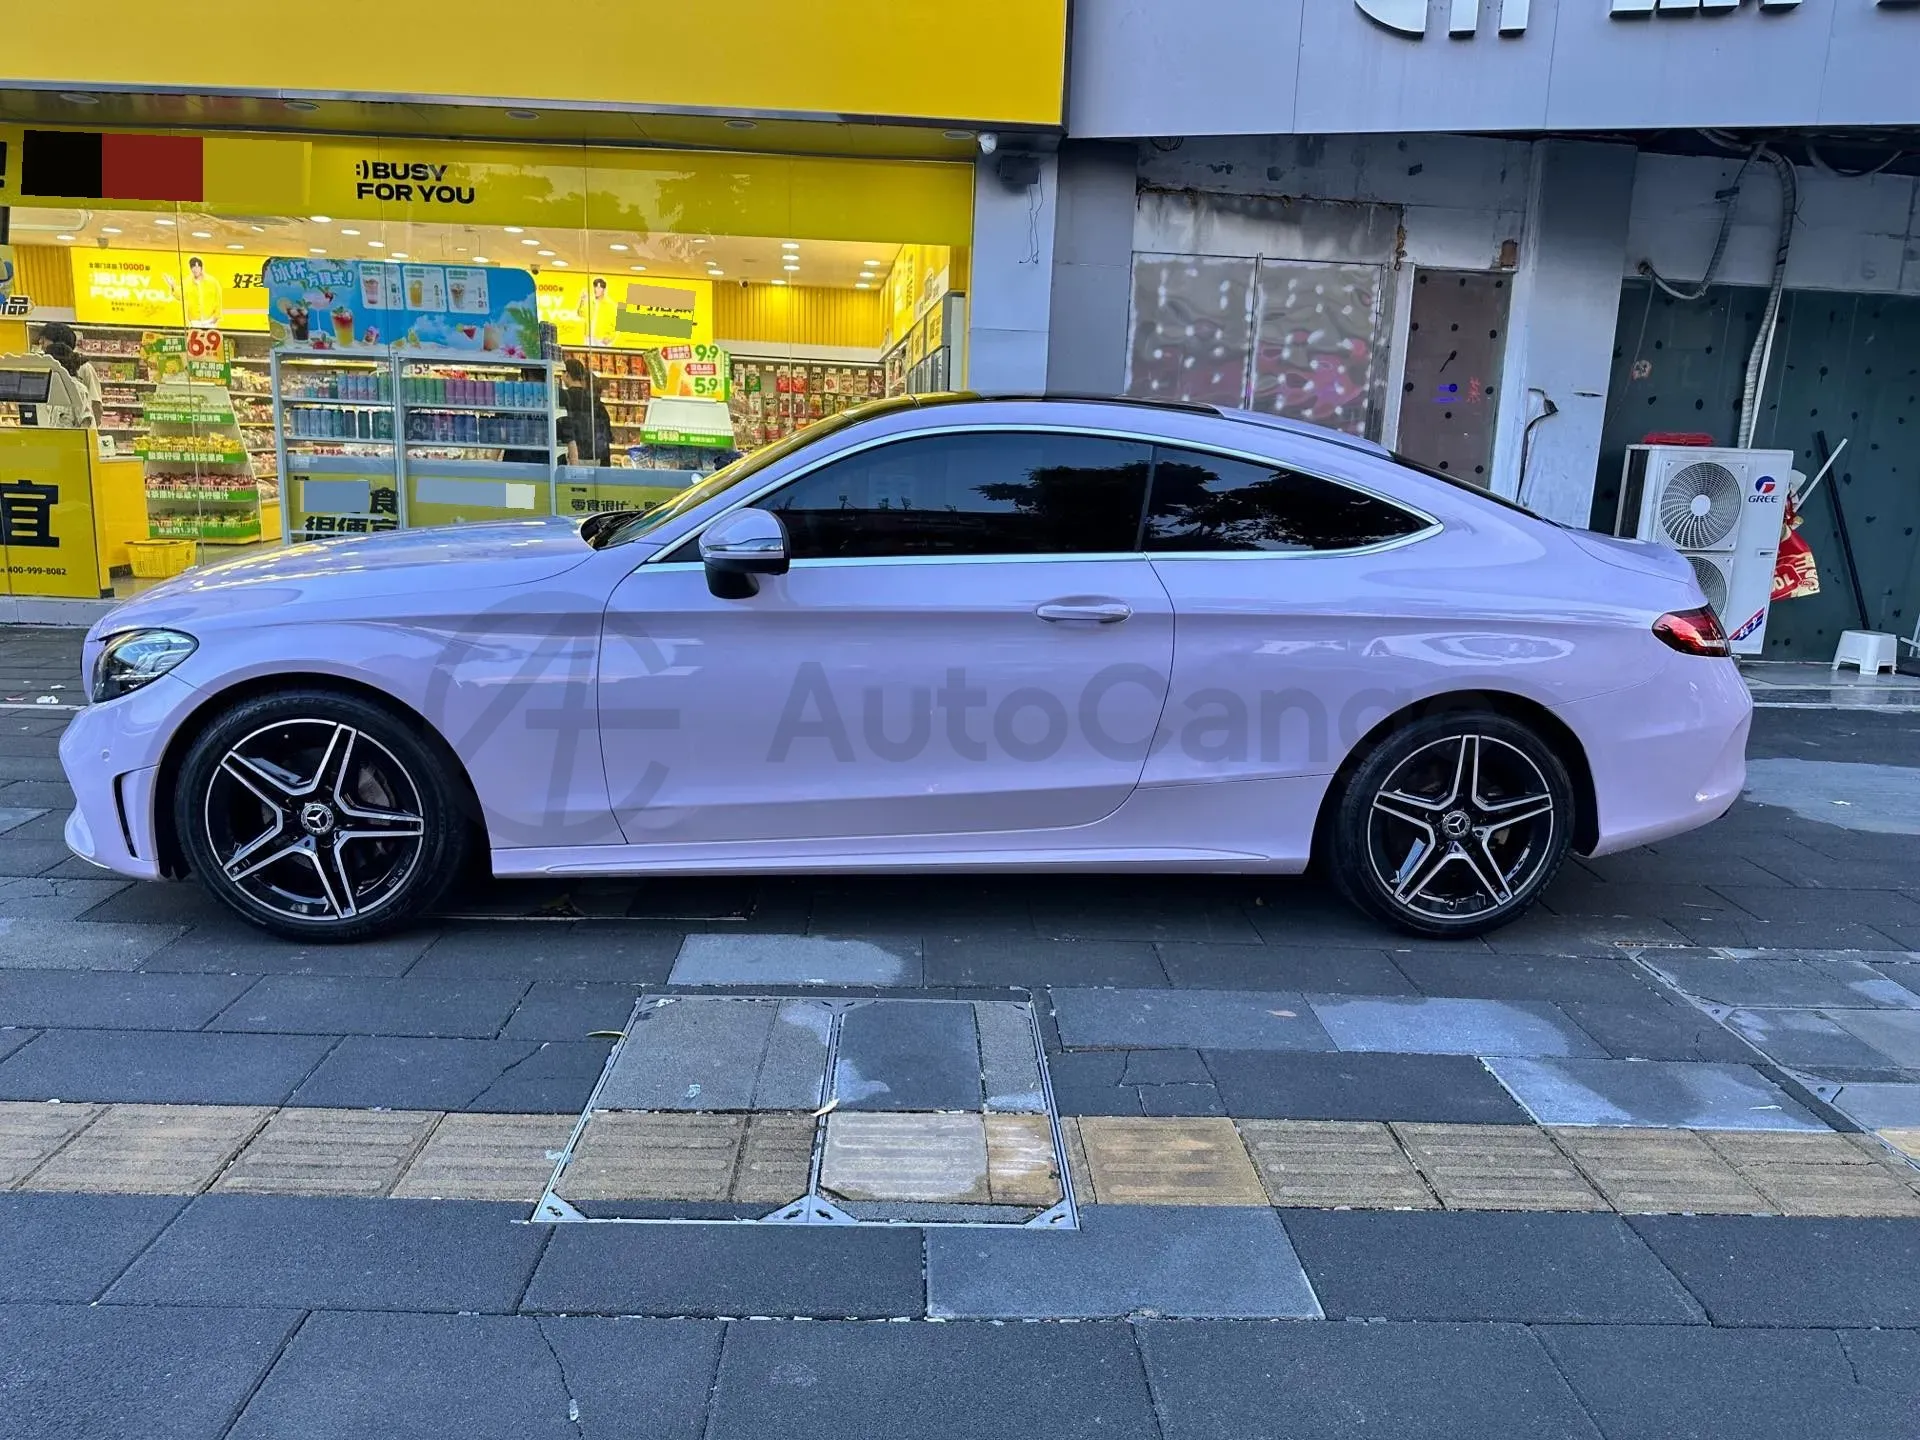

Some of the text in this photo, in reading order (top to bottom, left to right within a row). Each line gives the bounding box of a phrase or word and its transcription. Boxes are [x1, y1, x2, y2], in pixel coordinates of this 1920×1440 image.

[356, 182, 475, 204] FOR YOU
[188, 331, 221, 358] 6.9
[694, 344, 719, 362] 9.9
[694, 377, 719, 394] 5.9
[1747, 495, 1779, 504] GREE
[8, 567, 67, 576] 400-999-8082
